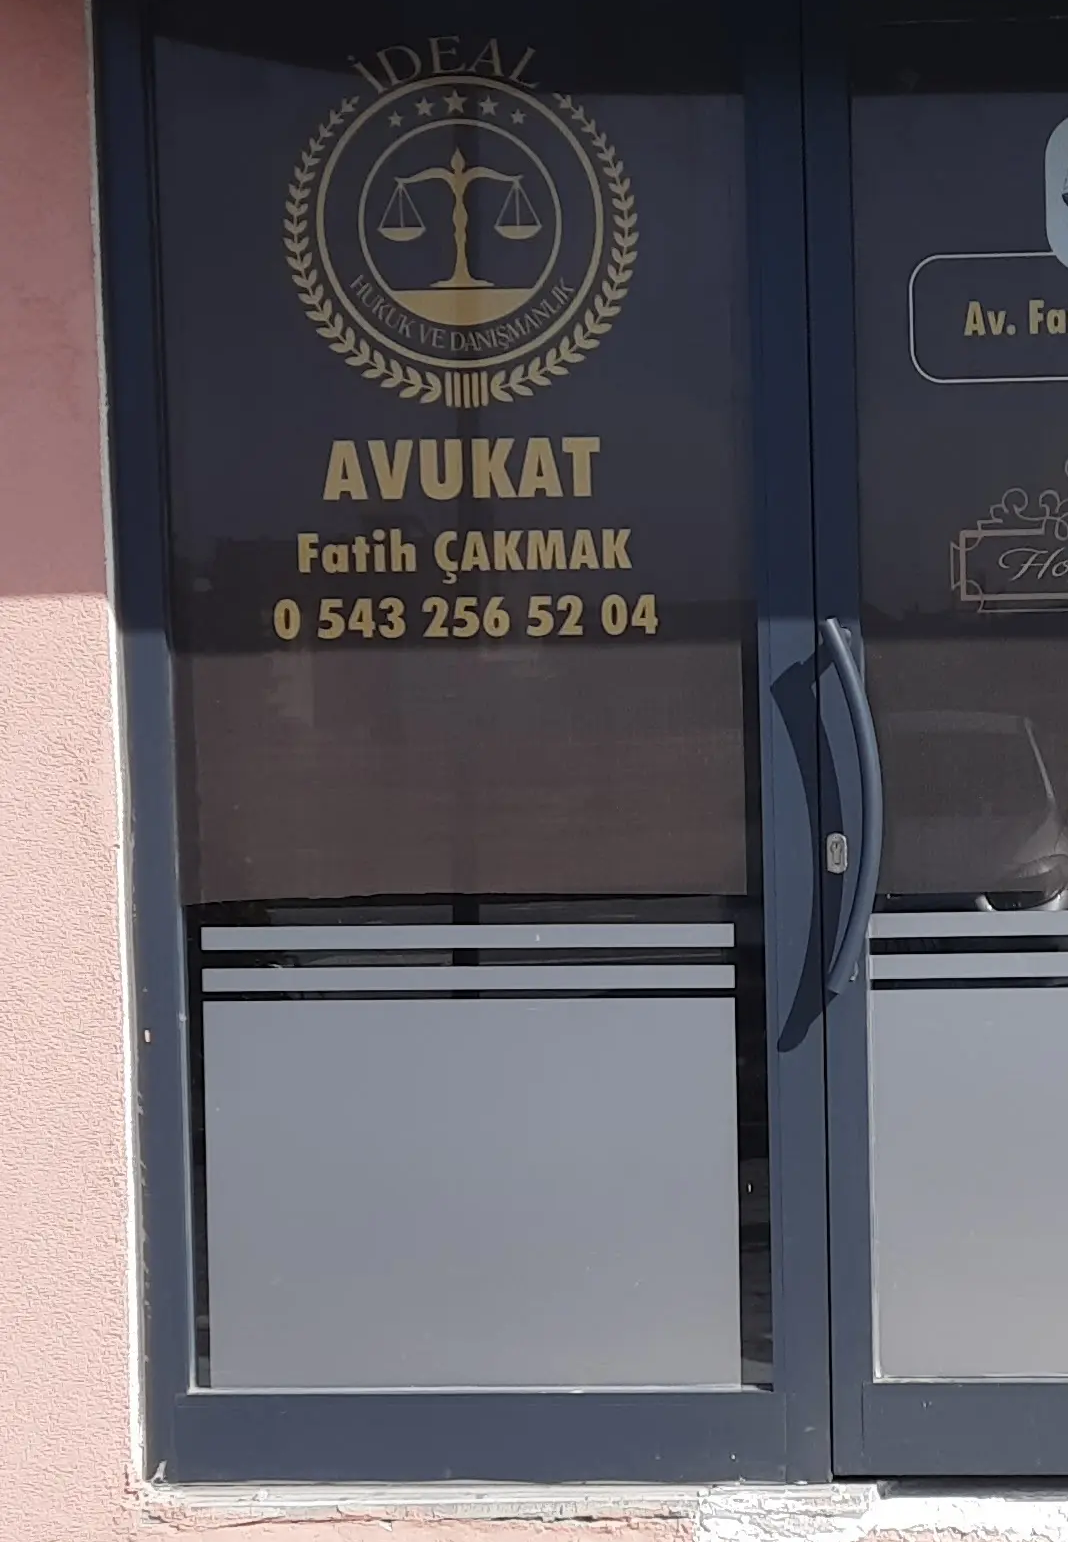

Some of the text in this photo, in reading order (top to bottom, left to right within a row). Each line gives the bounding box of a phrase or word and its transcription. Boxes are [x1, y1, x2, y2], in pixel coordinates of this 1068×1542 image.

[347, 34, 541, 96] İDEAL
[348, 273, 576, 353] HUKUK VE DANIŞMANLIK
[963, 300, 1017, 337] Av.
[323, 436, 601, 501] AVUKAT
[297, 528, 632, 583] Fatih ÇAKMAK
[272, 594, 659, 640] 0 543 256 52 04
